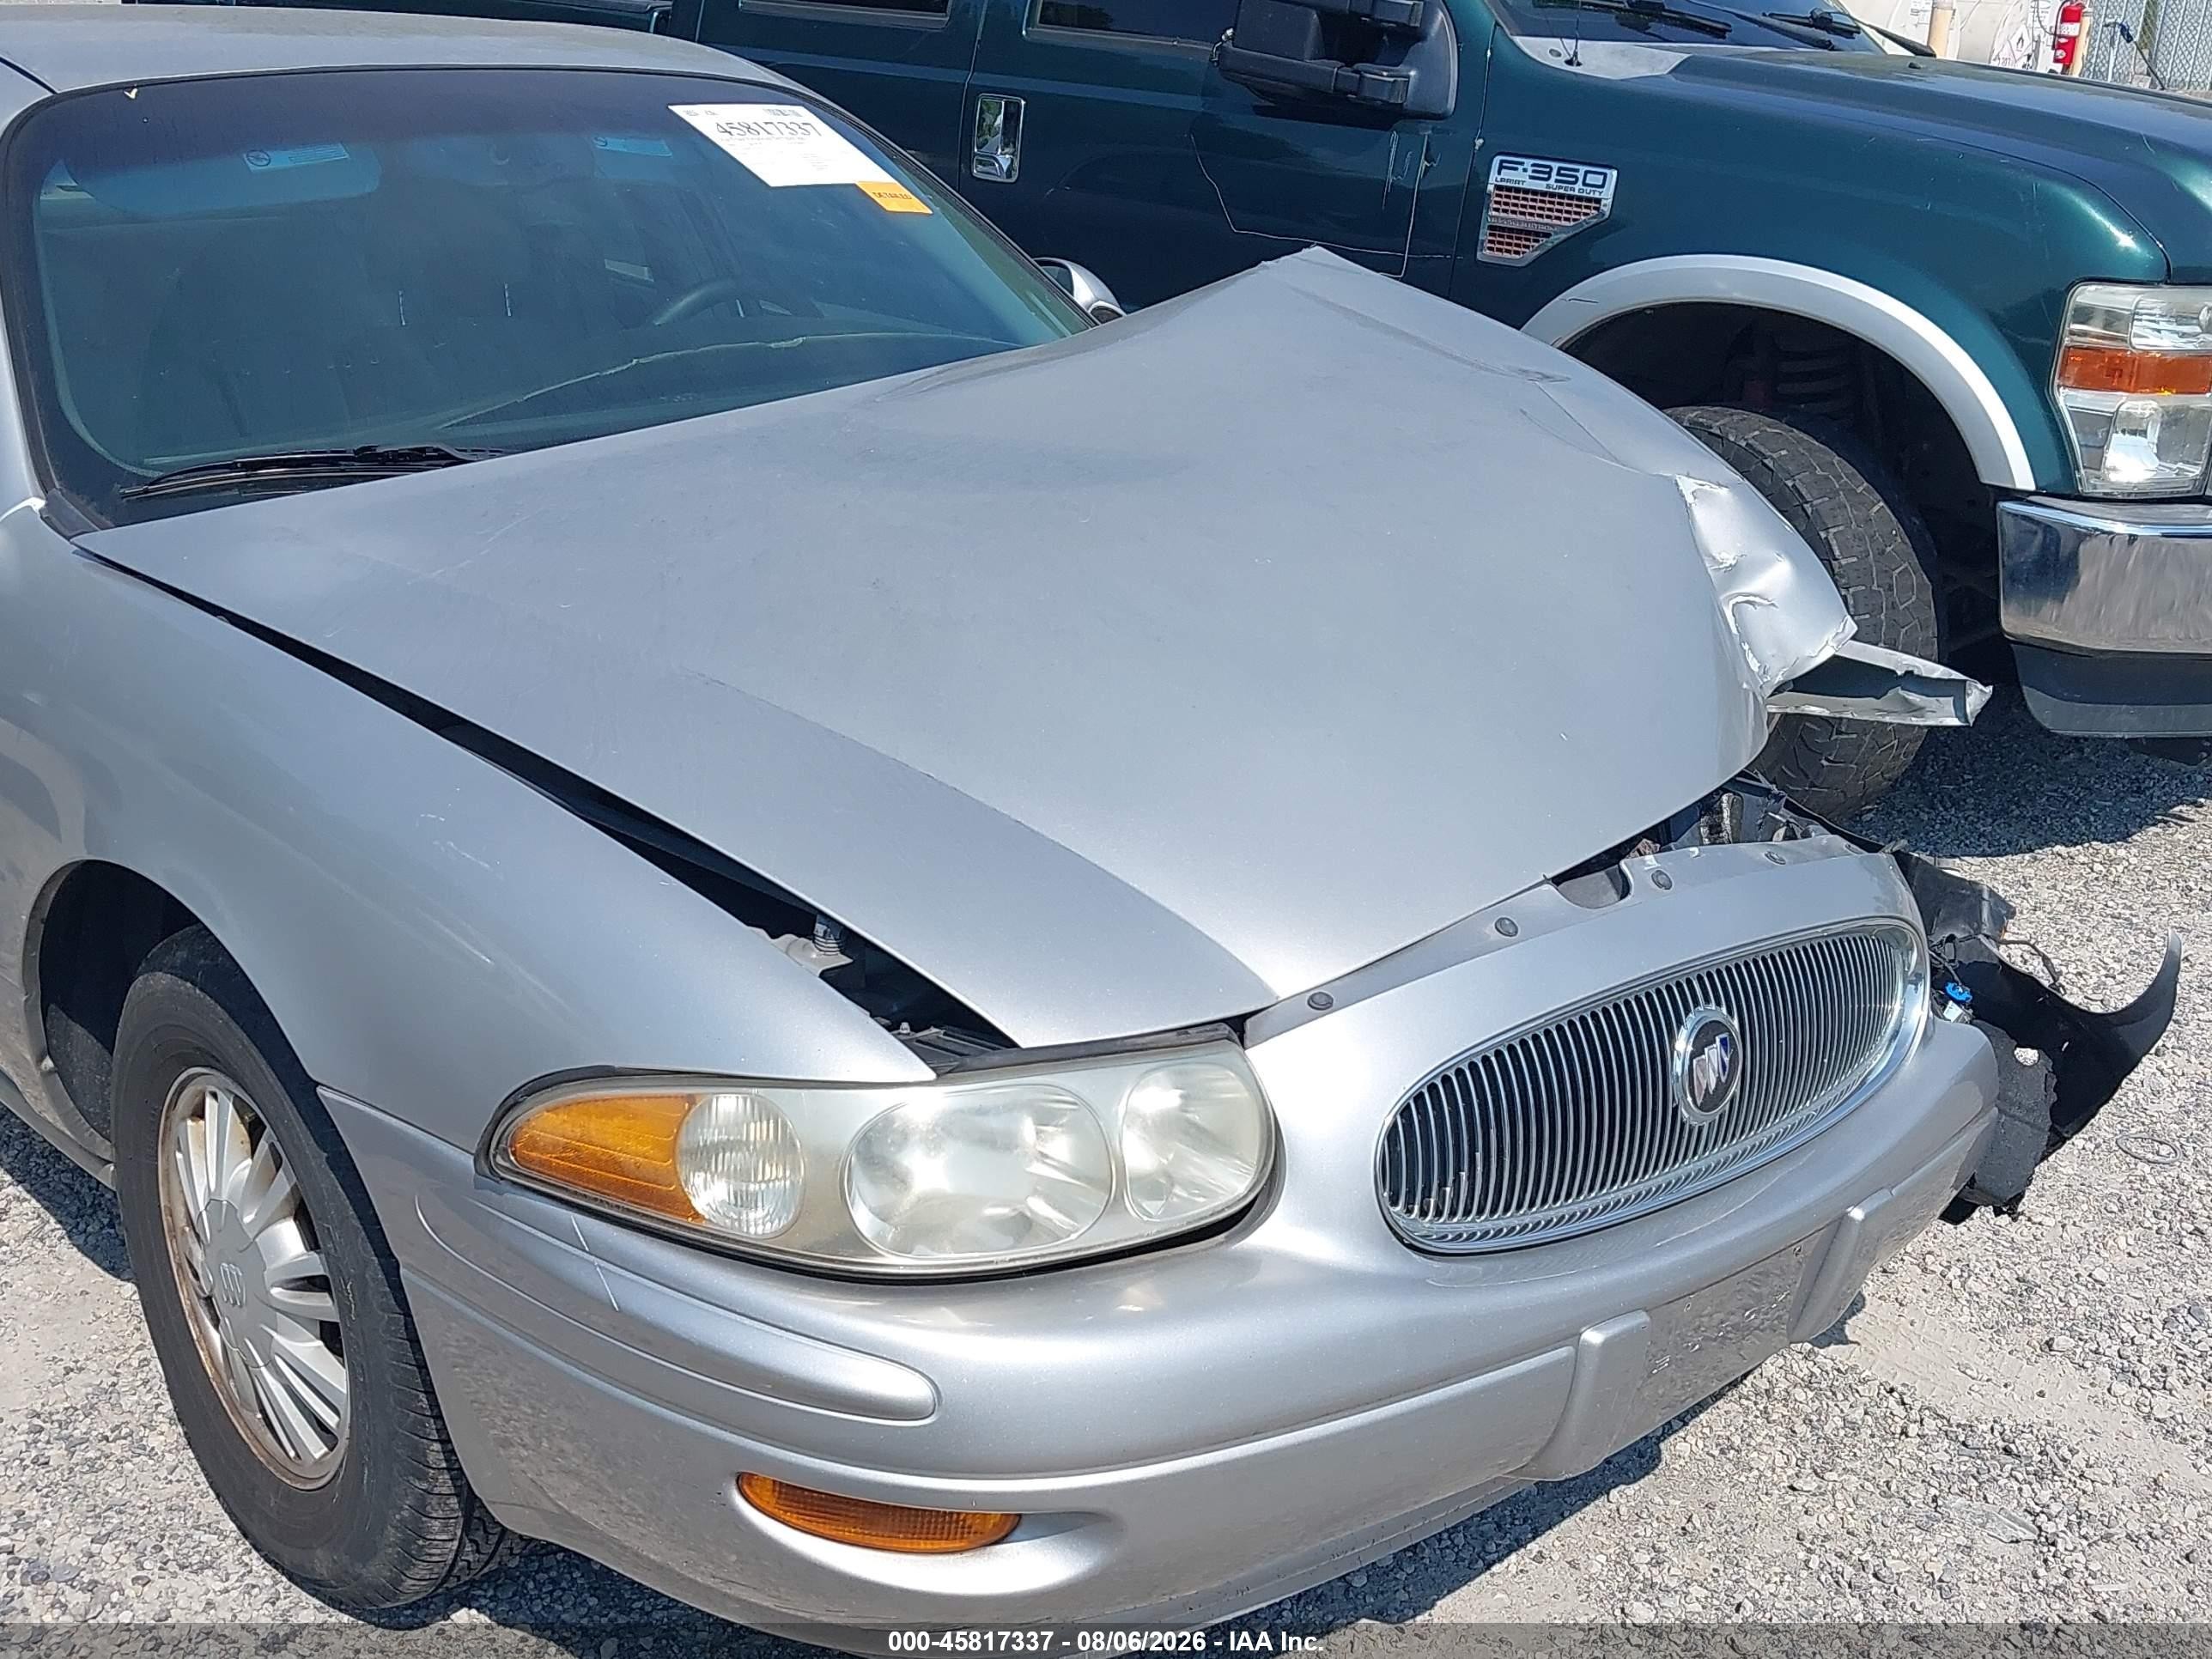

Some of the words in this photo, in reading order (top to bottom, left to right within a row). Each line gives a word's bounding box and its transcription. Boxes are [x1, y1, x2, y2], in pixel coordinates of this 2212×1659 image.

[716, 121, 822, 137] 45817337
[1494, 177, 1526, 186] LARIAT
[1546, 183, 1576, 193] SUPER
[1577, 188, 1604, 197] DUTY
